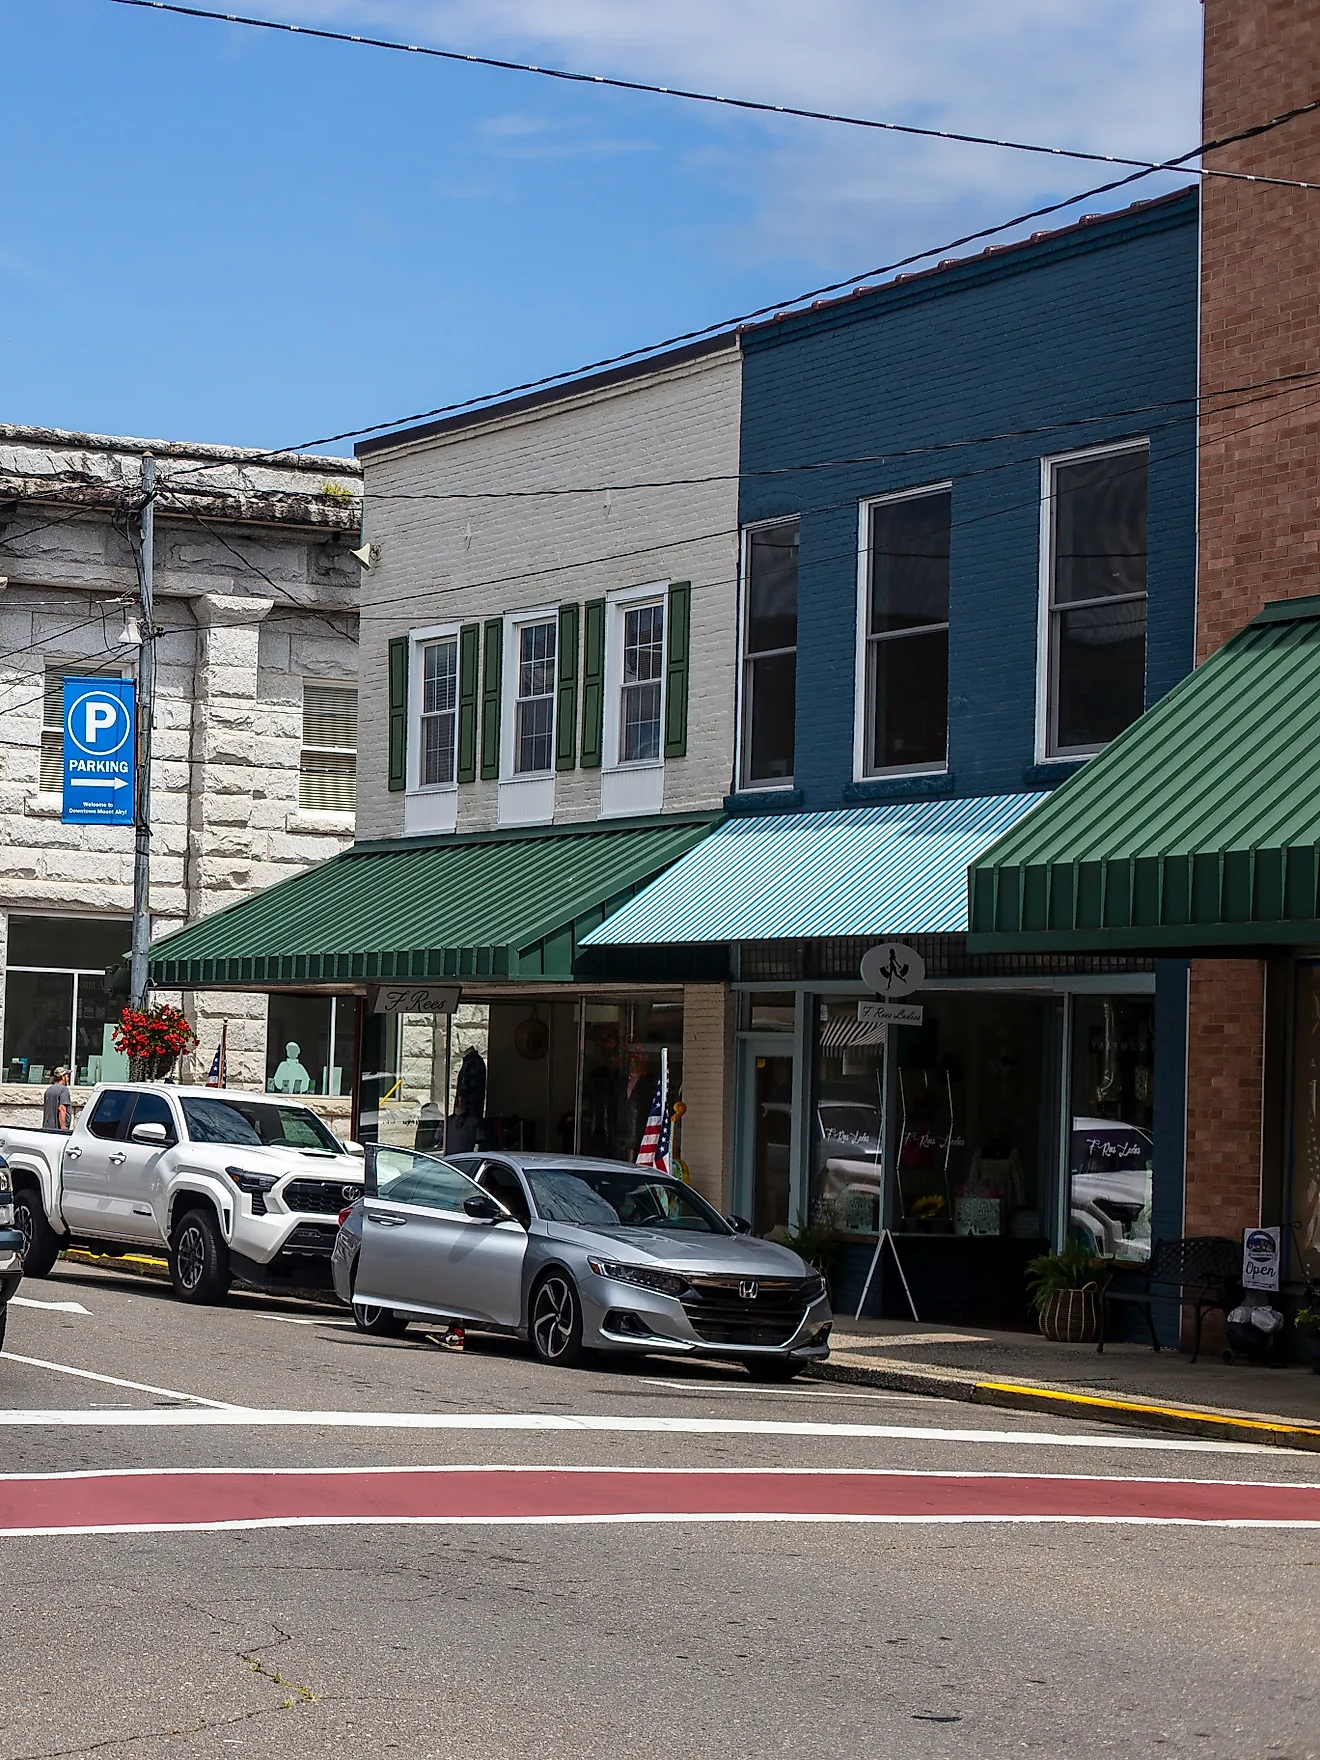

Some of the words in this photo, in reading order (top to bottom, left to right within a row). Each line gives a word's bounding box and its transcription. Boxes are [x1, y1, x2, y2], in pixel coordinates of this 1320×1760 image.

[86, 702, 117, 743] P
[69, 760, 129, 773] PARKING
[406, 990, 447, 1013] Rees
[1246, 1260, 1277, 1280] Open
